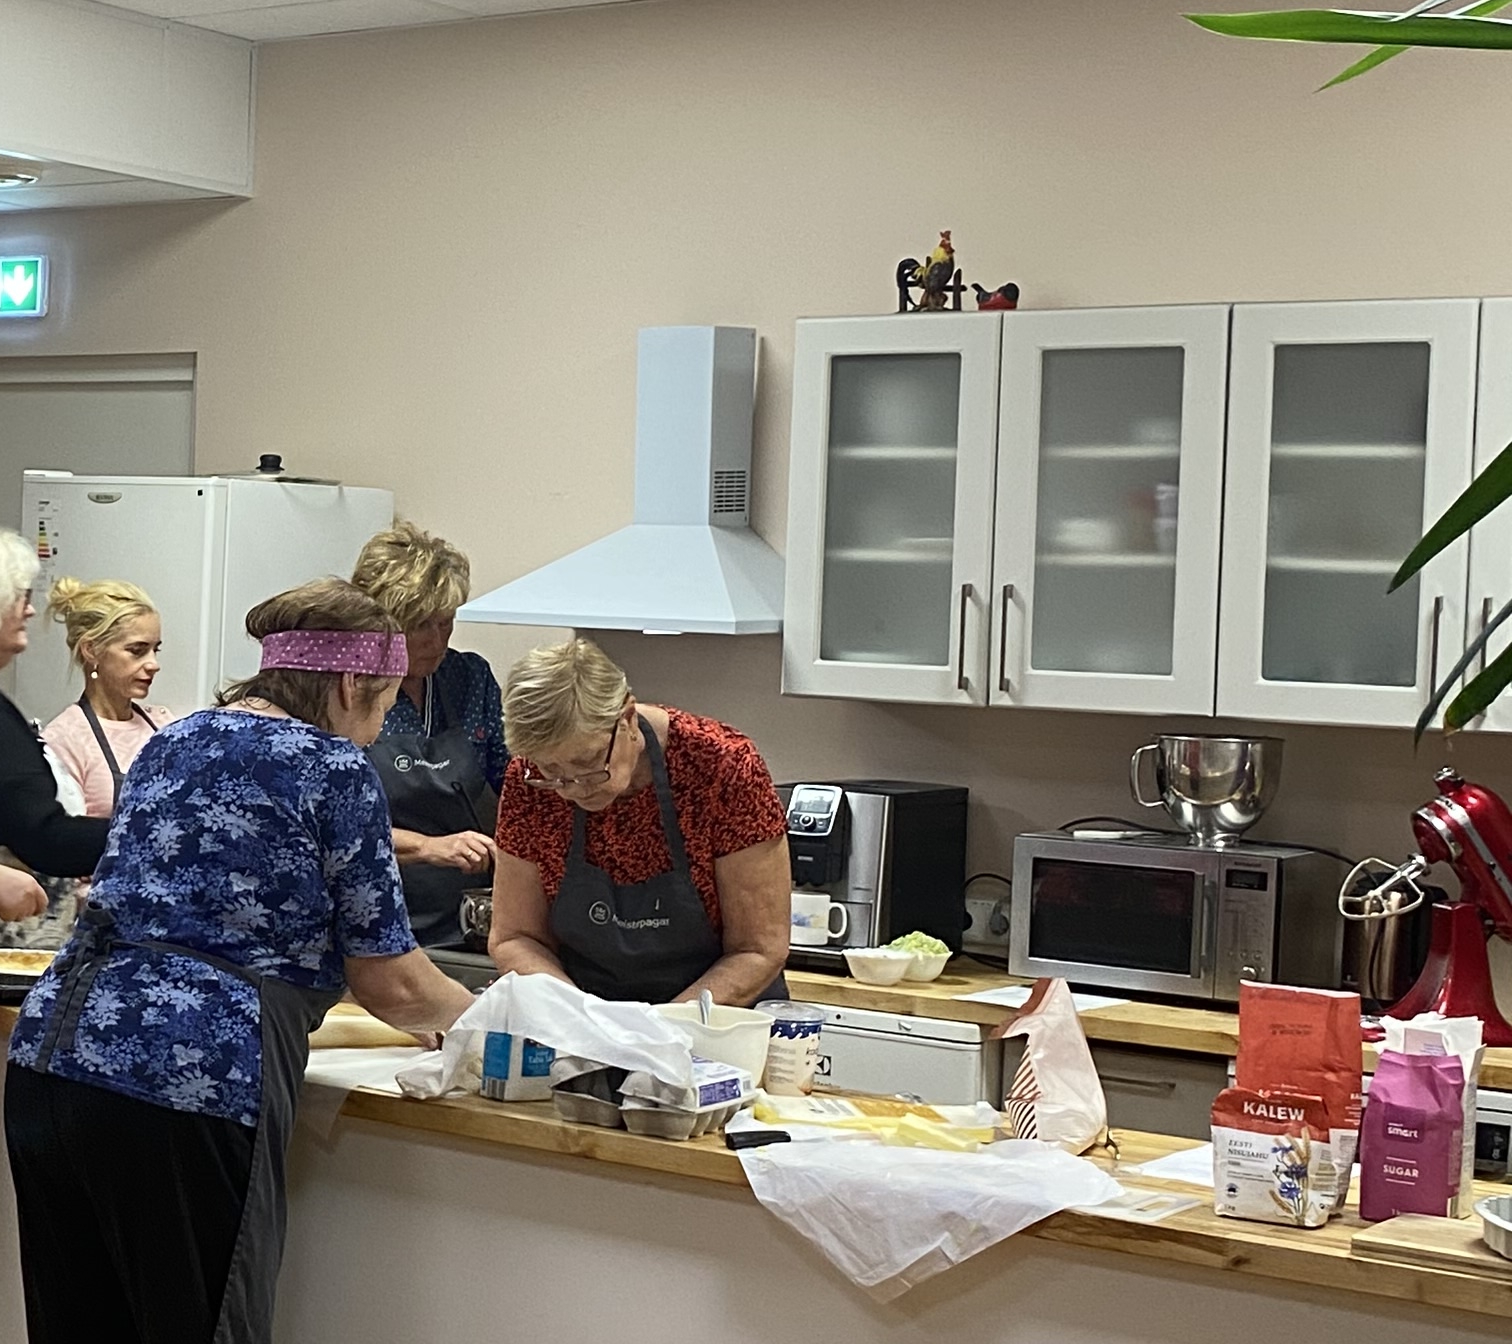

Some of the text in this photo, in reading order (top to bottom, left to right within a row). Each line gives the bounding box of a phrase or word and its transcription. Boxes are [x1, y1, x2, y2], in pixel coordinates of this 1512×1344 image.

[1243, 1101, 1305, 1122] KALEW
[1387, 1126, 1418, 1139] smart
[1228, 1139, 1253, 1149] EESTI
[1383, 1164, 1419, 1178] SUGAR
